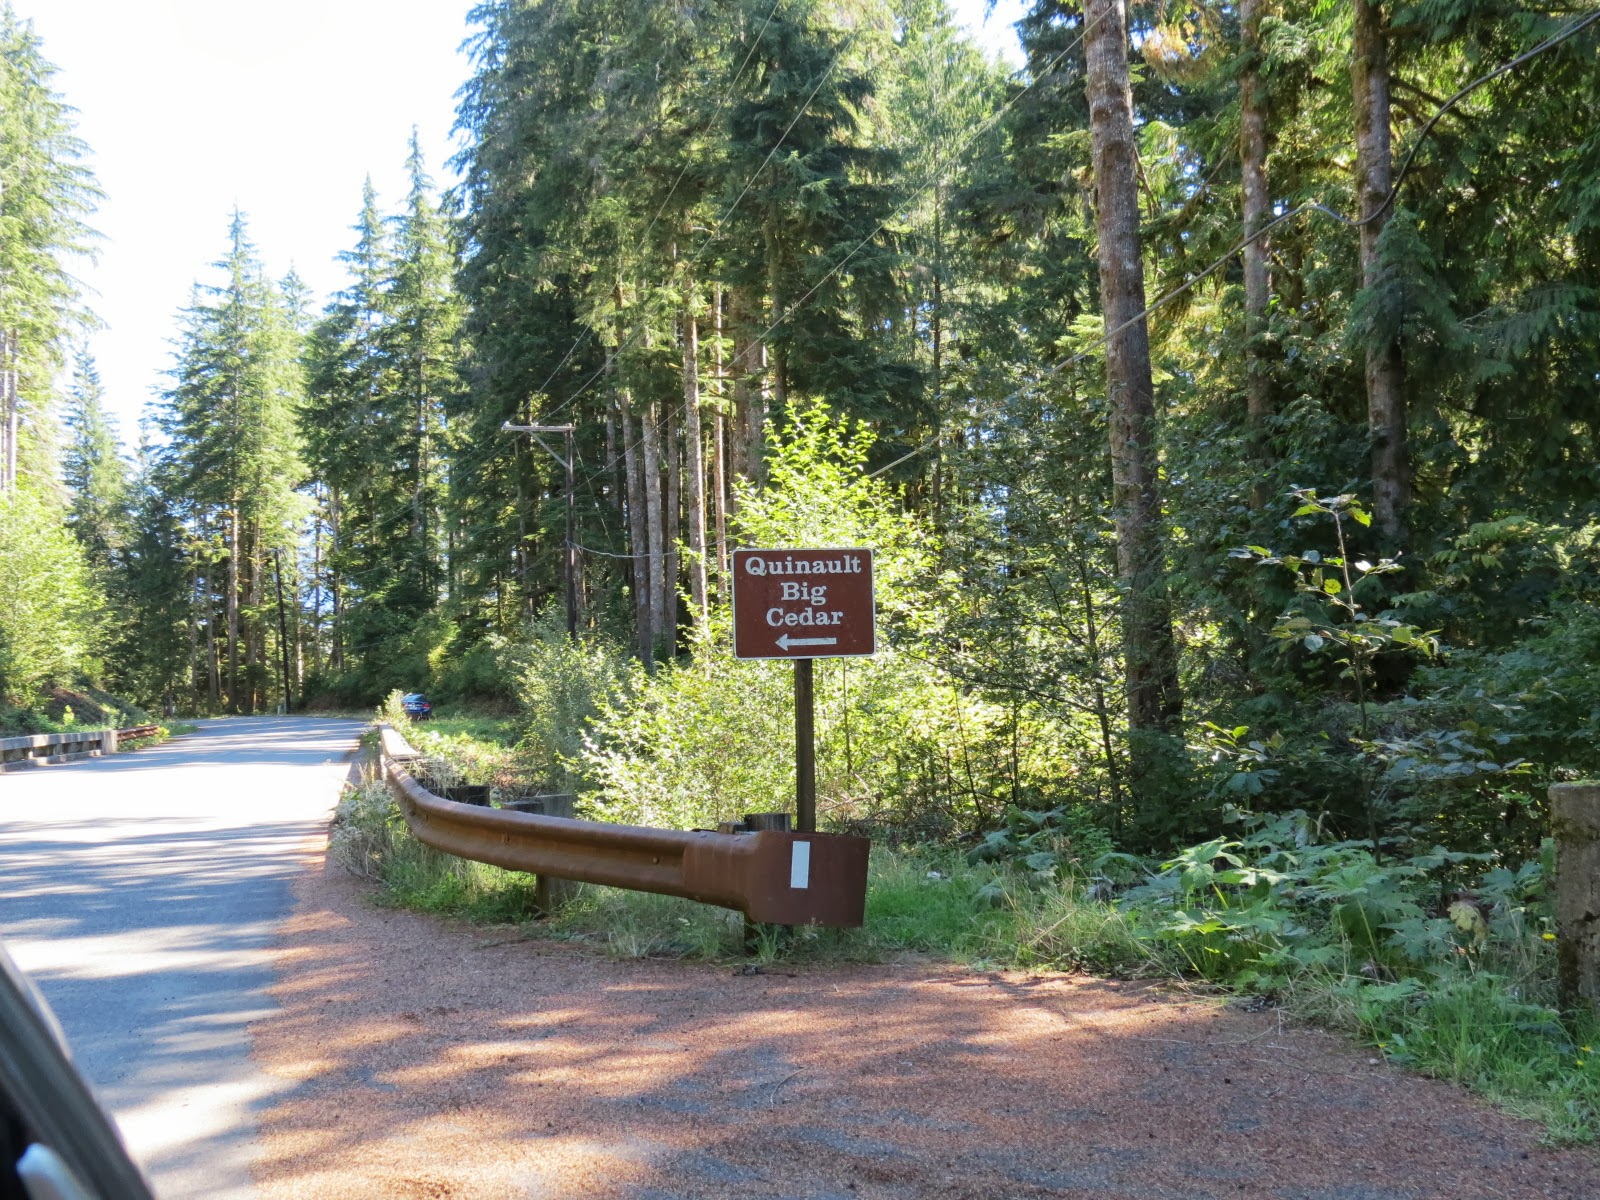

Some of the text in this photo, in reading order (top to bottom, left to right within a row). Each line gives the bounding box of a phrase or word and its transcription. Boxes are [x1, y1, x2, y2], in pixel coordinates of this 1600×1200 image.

[745, 555, 861, 576] Quinault
[780, 582, 827, 606] Big
[766, 607, 843, 627] Cedar
